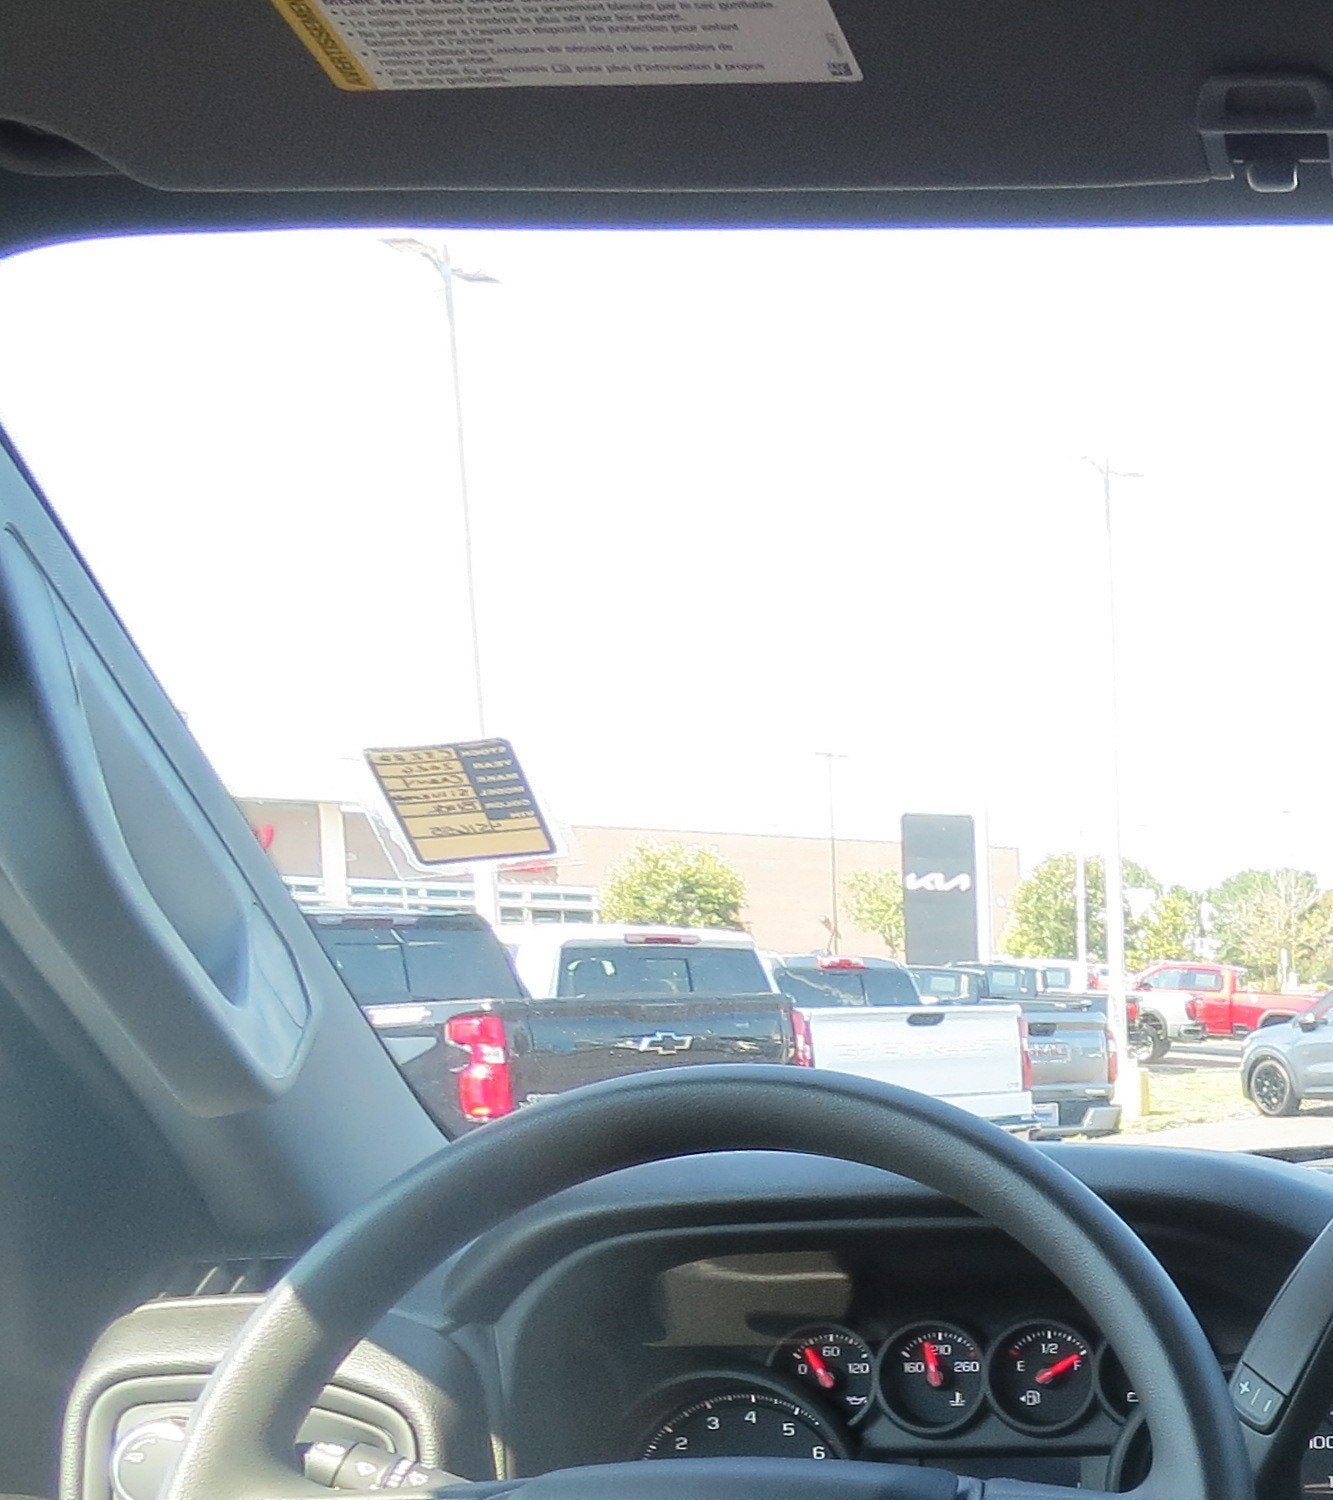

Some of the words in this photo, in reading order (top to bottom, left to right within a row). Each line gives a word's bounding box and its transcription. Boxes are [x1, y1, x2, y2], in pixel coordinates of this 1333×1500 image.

[905, 872, 971, 891] KIA
[822, 1346, 840, 1357] 60
[932, 1344, 952, 1355] 210
[1041, 1343, 1058, 1354] 1/2
[798, 1363, 808, 1375] 0
[848, 1363, 869, 1374] 120
[903, 1361, 925, 1373] 160
[954, 1361, 979, 1373] 260
[1016, 1360, 1025, 1371] E
[1073, 1360, 1082, 1371] F
[706, 1416, 720, 1430] 3
[744, 1410, 757, 1424] 4
[782, 1422, 795, 1436] 5
[675, 1436, 689, 1450] 2
[812, 1446, 826, 1460] 6
